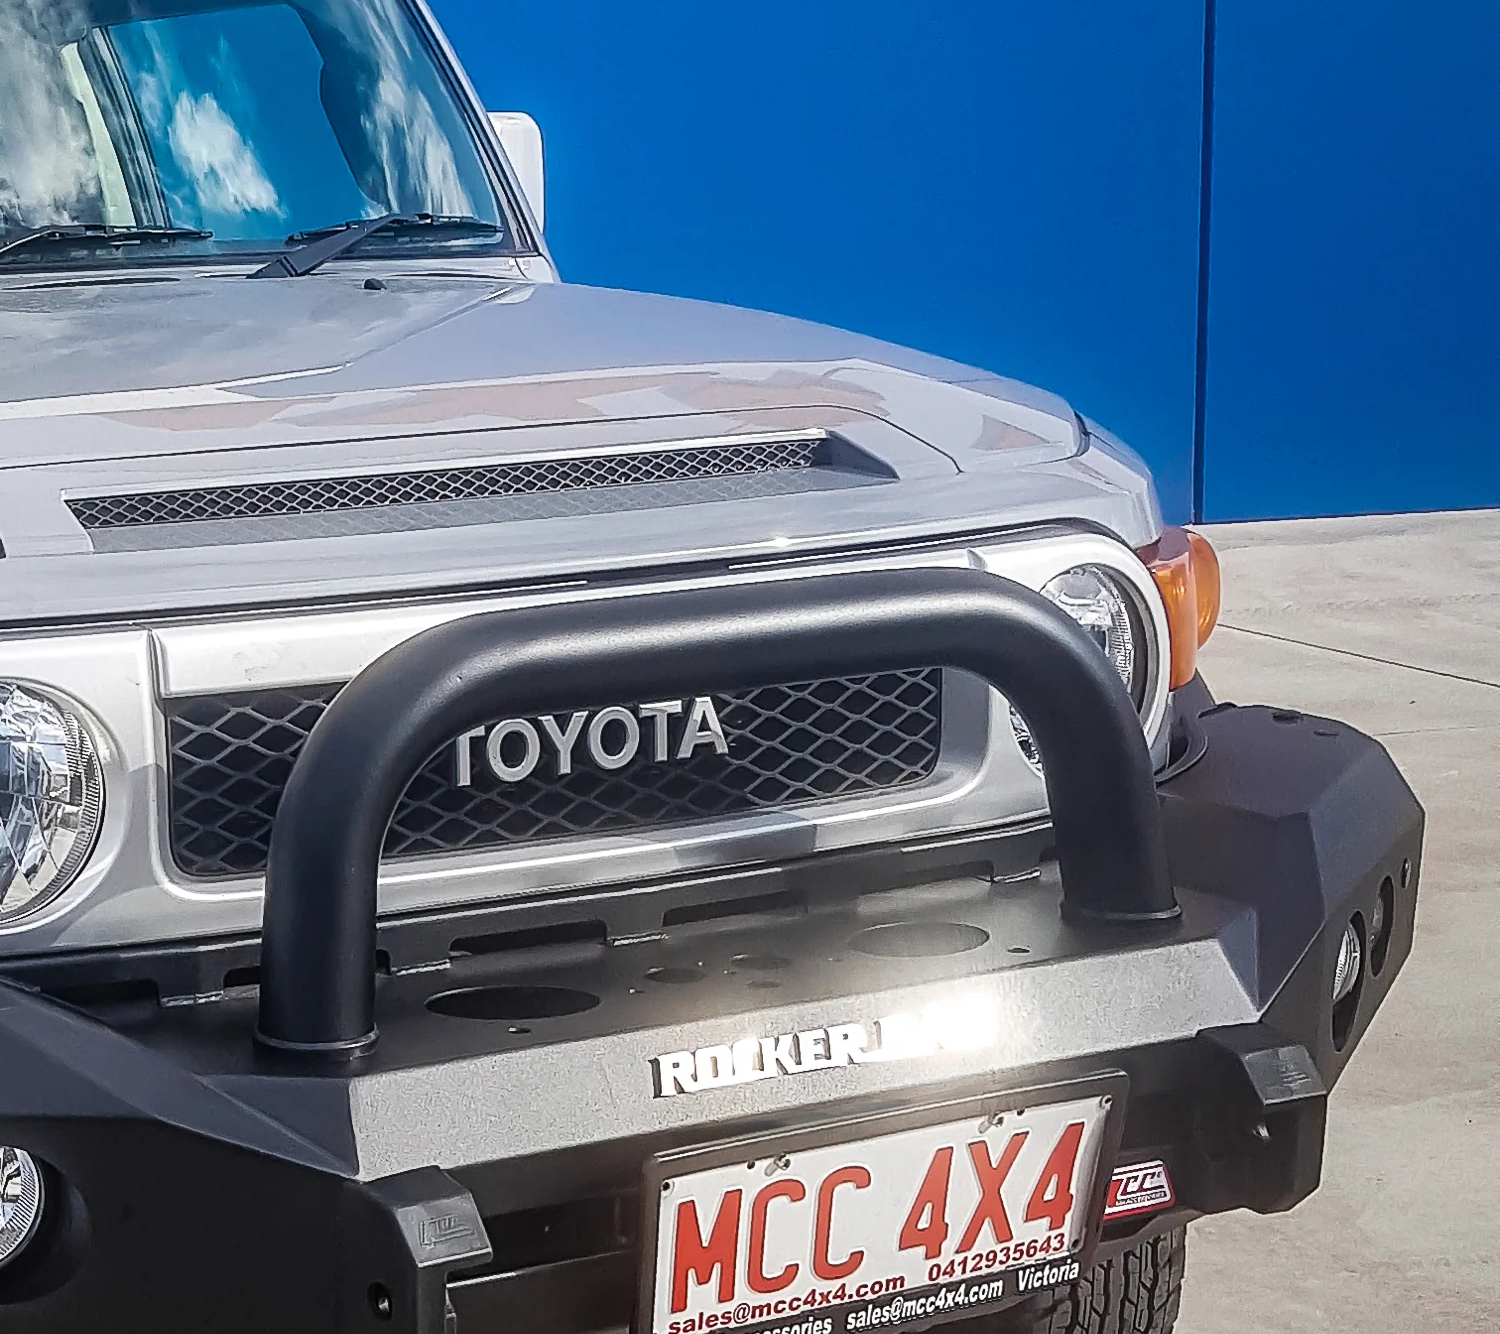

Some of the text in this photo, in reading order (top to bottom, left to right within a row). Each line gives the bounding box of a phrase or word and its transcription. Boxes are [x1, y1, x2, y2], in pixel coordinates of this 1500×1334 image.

[457, 696, 729, 787] TOYOTA
[651, 1021, 868, 1098] ROCKER
[671, 1121, 1085, 1314] MCC 4X4
[846, 1279, 1003, 1330] sales@mcc4x4.com
[1017, 1259, 1080, 1292] Victoria
[928, 1233, 1066, 1281] 0412935643
